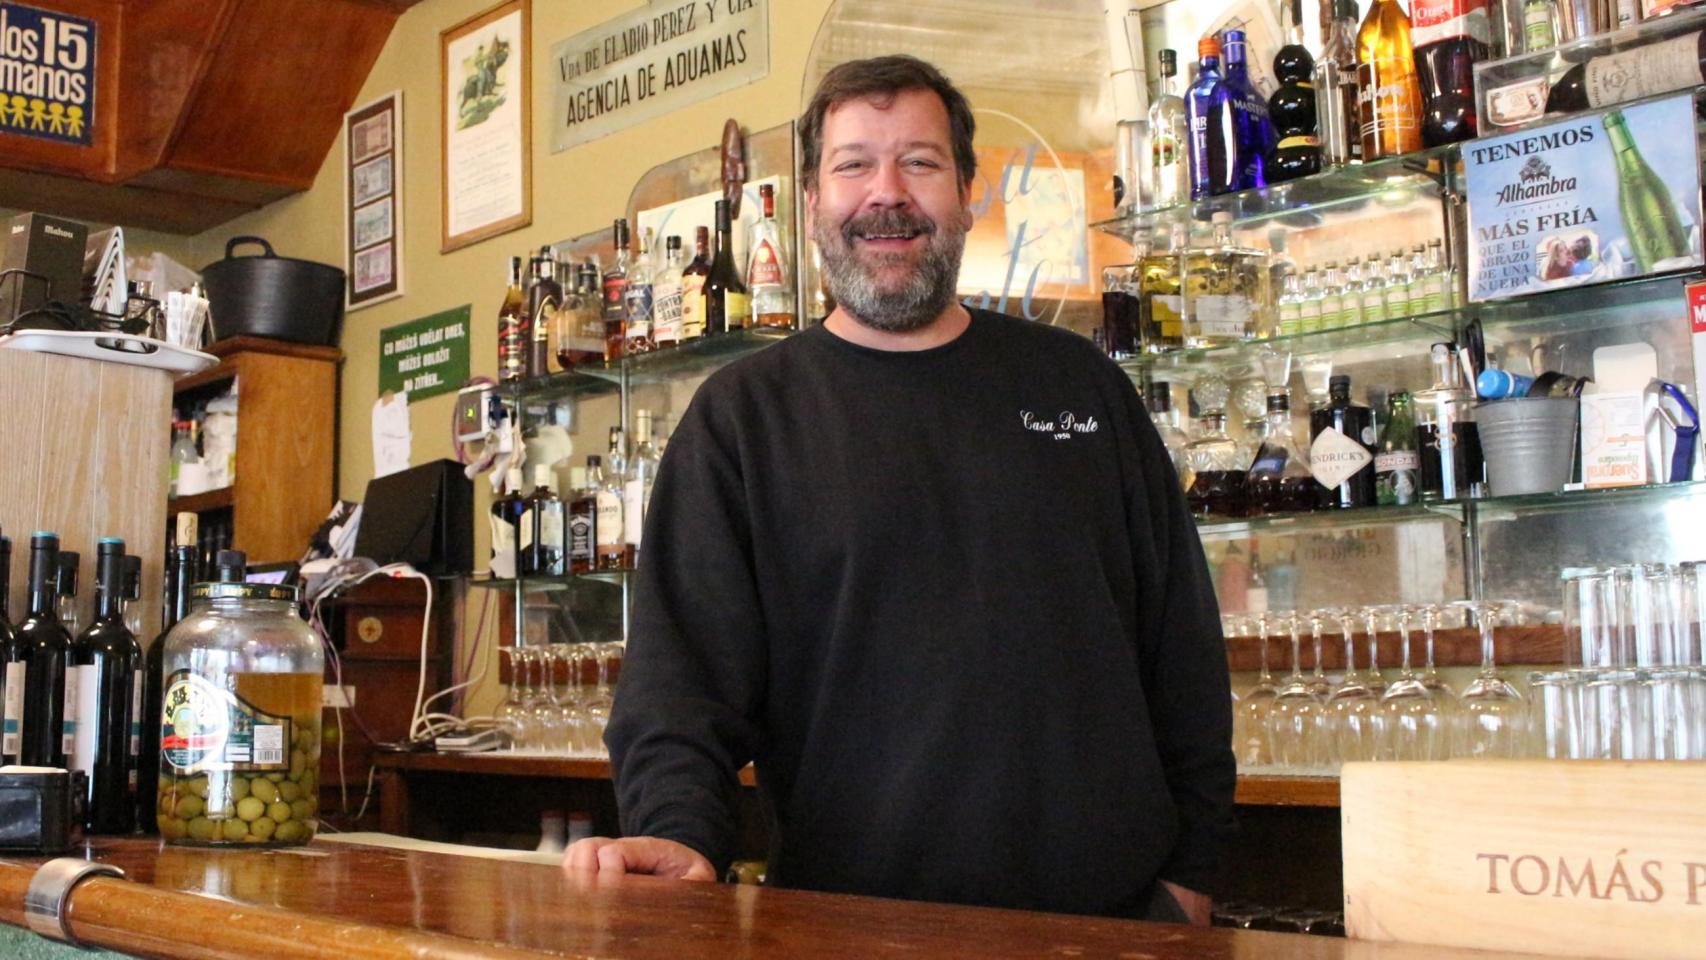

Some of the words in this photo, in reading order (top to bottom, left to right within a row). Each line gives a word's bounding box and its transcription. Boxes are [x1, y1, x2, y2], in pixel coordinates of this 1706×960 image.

[0, 8, 39, 62] los
[41, 17, 88, 70] 15
[585, 47, 600, 73] DE
[604, 22, 648, 65] ELADIO
[653, 2, 697, 47] PEREZ
[705, 0, 717, 23] Y
[566, 74, 631, 128] AGENCIA
[638, 63, 656, 101] DE
[664, 29, 748, 92] ADUANAS
[1471, 125, 1594, 165] TENEMOS
[1496, 176, 1577, 207] Alhambra
[44, 224, 74, 239] Mahou
[1478, 218, 1529, 243] MÁS
[1537, 205, 1599, 232] FRÍA
[1479, 242, 1505, 258] QUE
[1512, 239, 1530, 252] EL
[1480, 250, 1529, 270] ABRAZO
[1478, 276, 1530, 293] NUERA
[1479, 268, 1497, 282] DE
[1503, 263, 1530, 278] UNA
[1020, 409, 1054, 431] Casa
[1060, 410, 1098, 432] Ponte
[1476, 849, 1665, 903] TOMÁS
